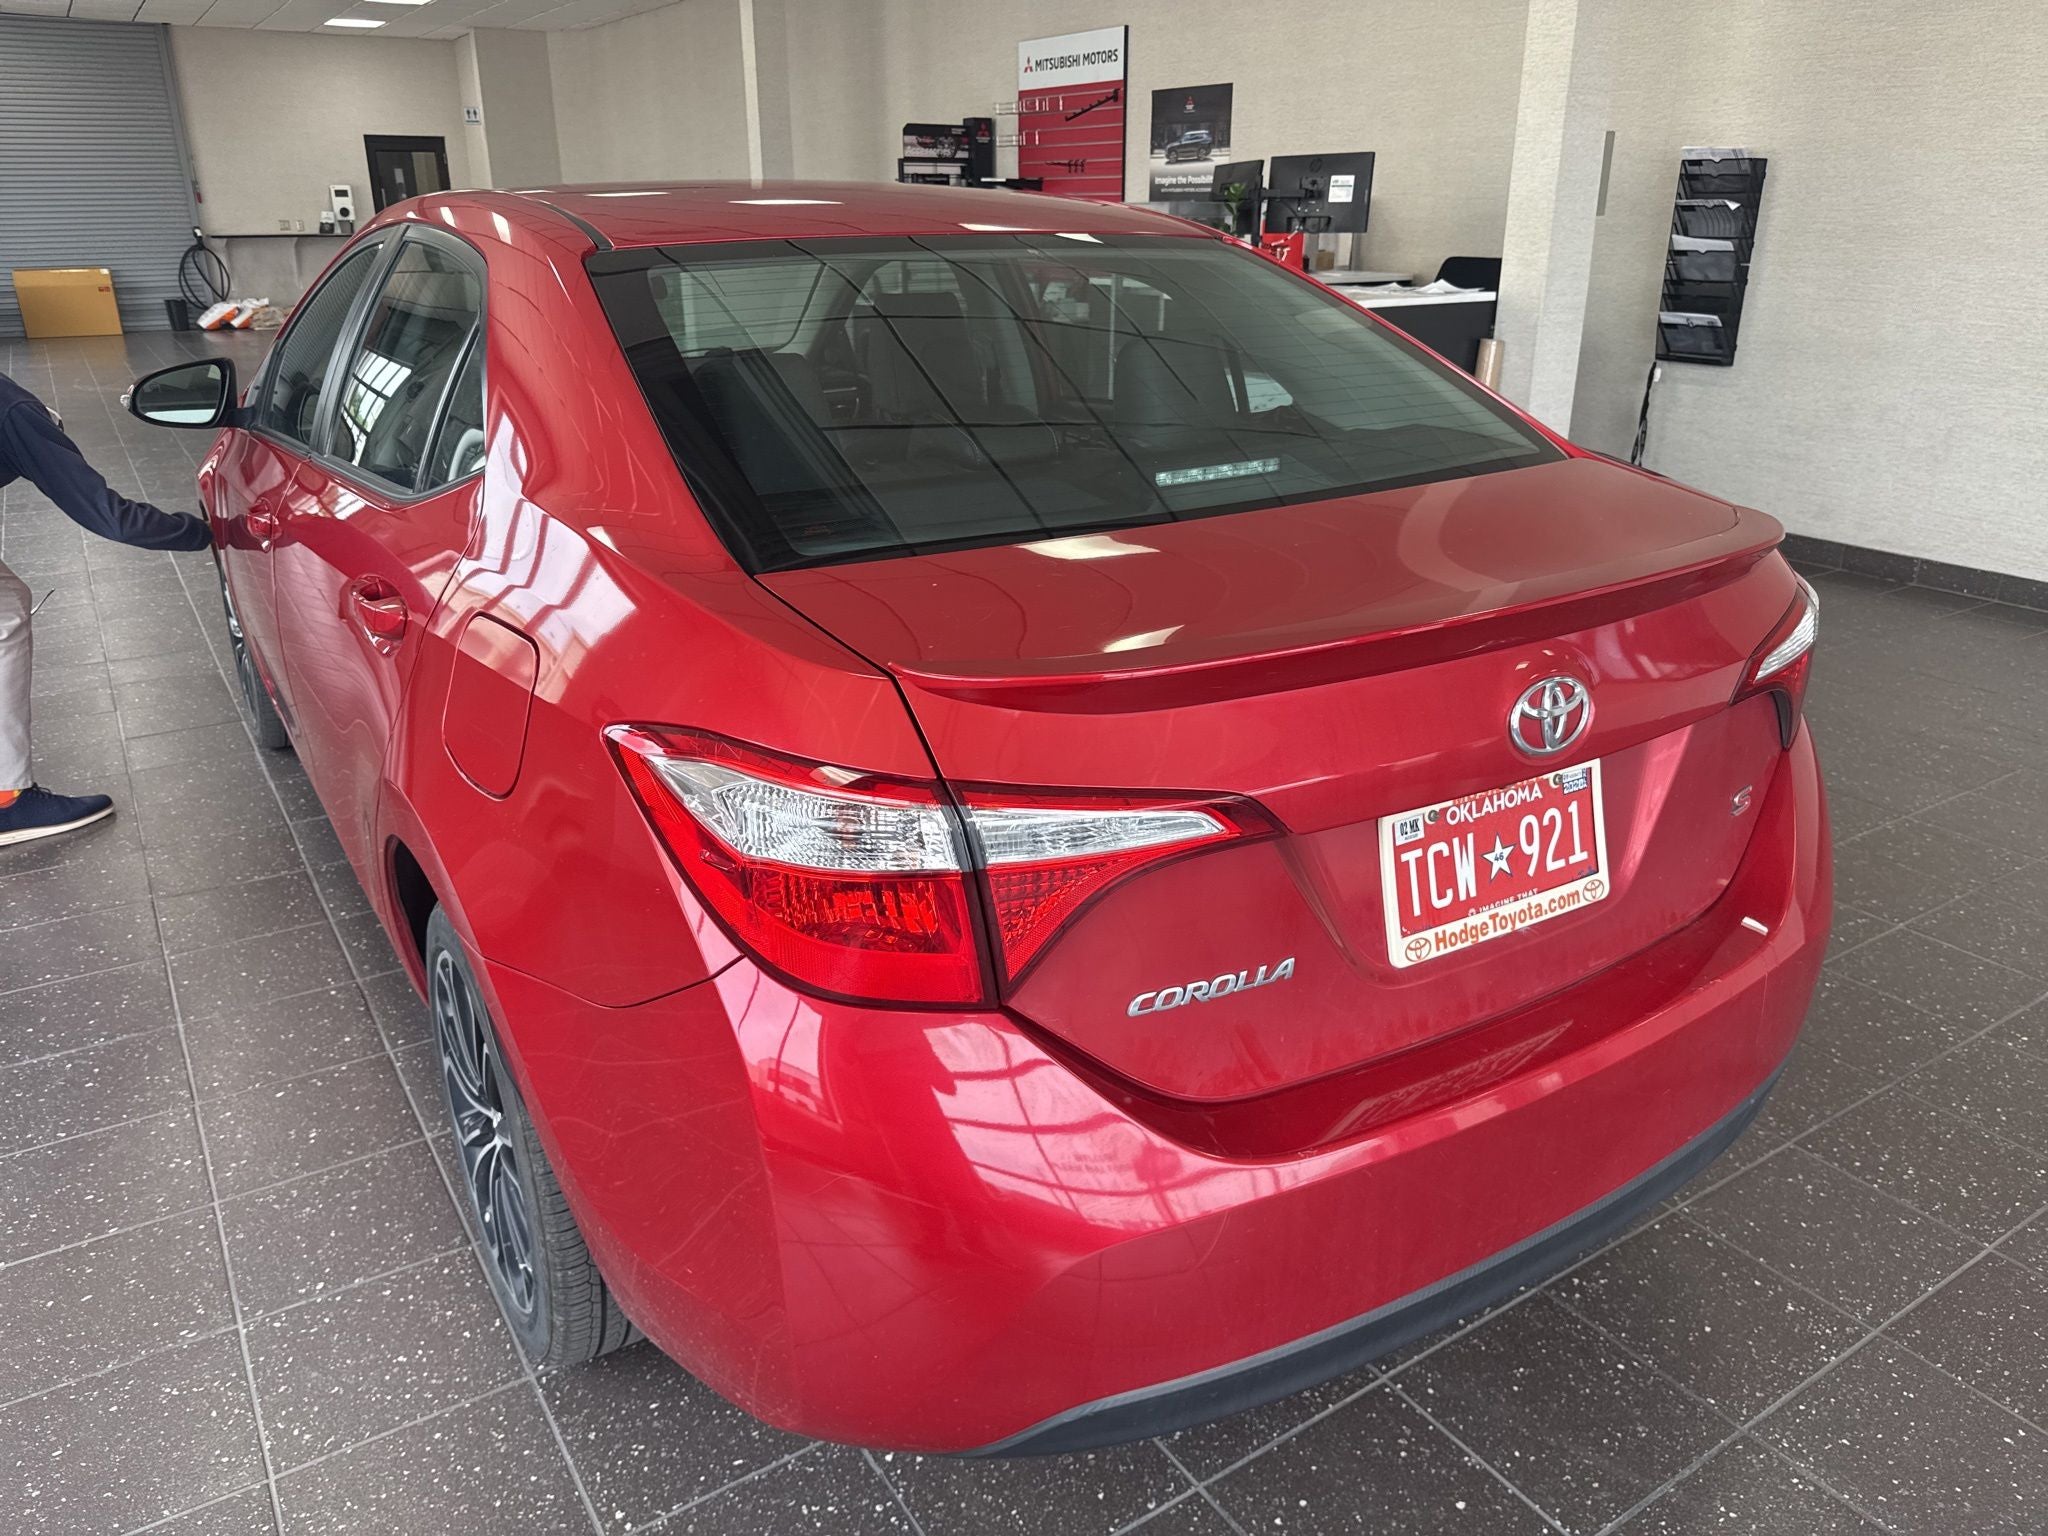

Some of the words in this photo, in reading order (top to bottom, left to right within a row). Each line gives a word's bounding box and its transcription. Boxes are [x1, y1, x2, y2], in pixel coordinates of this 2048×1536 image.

[1035, 54, 1081, 72] MITSUBISHI
[1082, 48, 1119, 66] MOTORS
[1187, 174, 1214, 184] Possibilit
[1446, 782, 1543, 826] OKLAHOMA
[1730, 785, 1753, 817] S
[1400, 832, 1478, 918] TCW
[1519, 800, 1589, 877] 921
[1479, 895, 1516, 912] IMAGINE
[1516, 887, 1538, 901] THAT
[1434, 888, 1581, 953] HodgeToyota.com
[1126, 957, 1296, 1017] COROLLA
